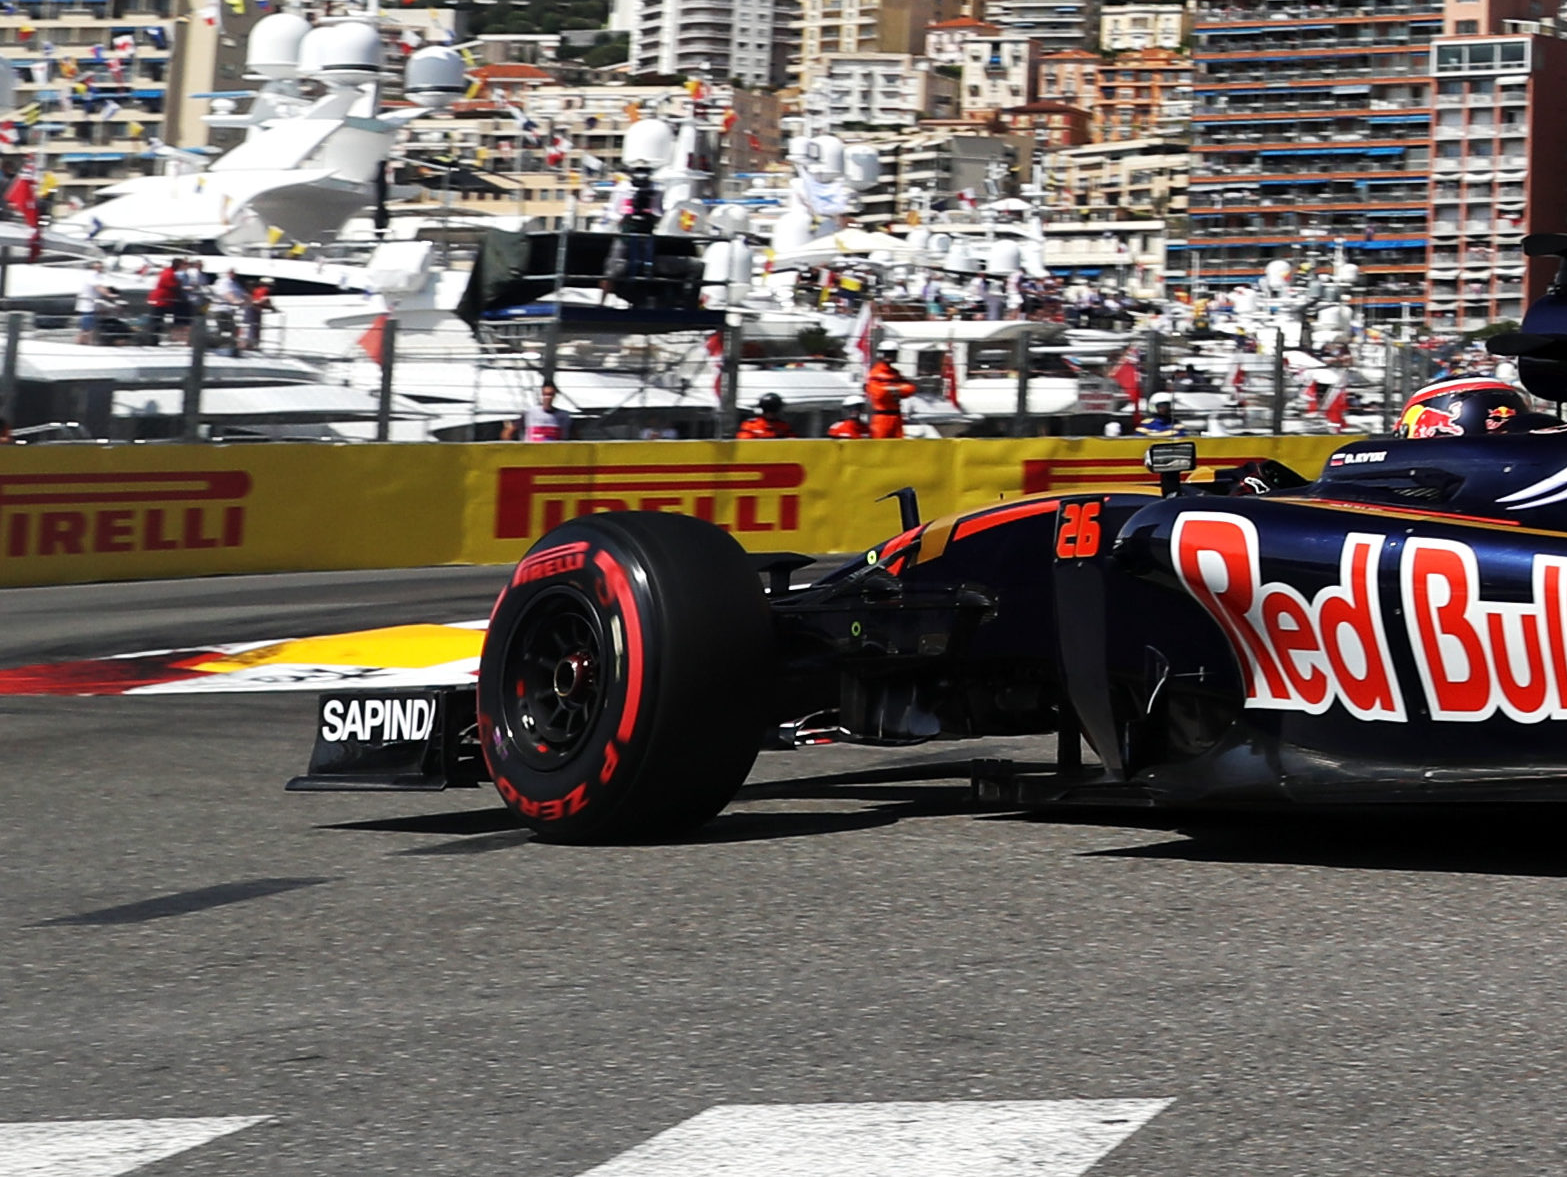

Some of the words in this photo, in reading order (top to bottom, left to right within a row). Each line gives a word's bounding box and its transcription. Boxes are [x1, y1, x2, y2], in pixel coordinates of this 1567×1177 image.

[1057, 503, 1101, 558] 26
[511, 540, 590, 589] PIRELLI
[1174, 514, 1406, 721] Red
[497, 775, 590, 821] ZERO
